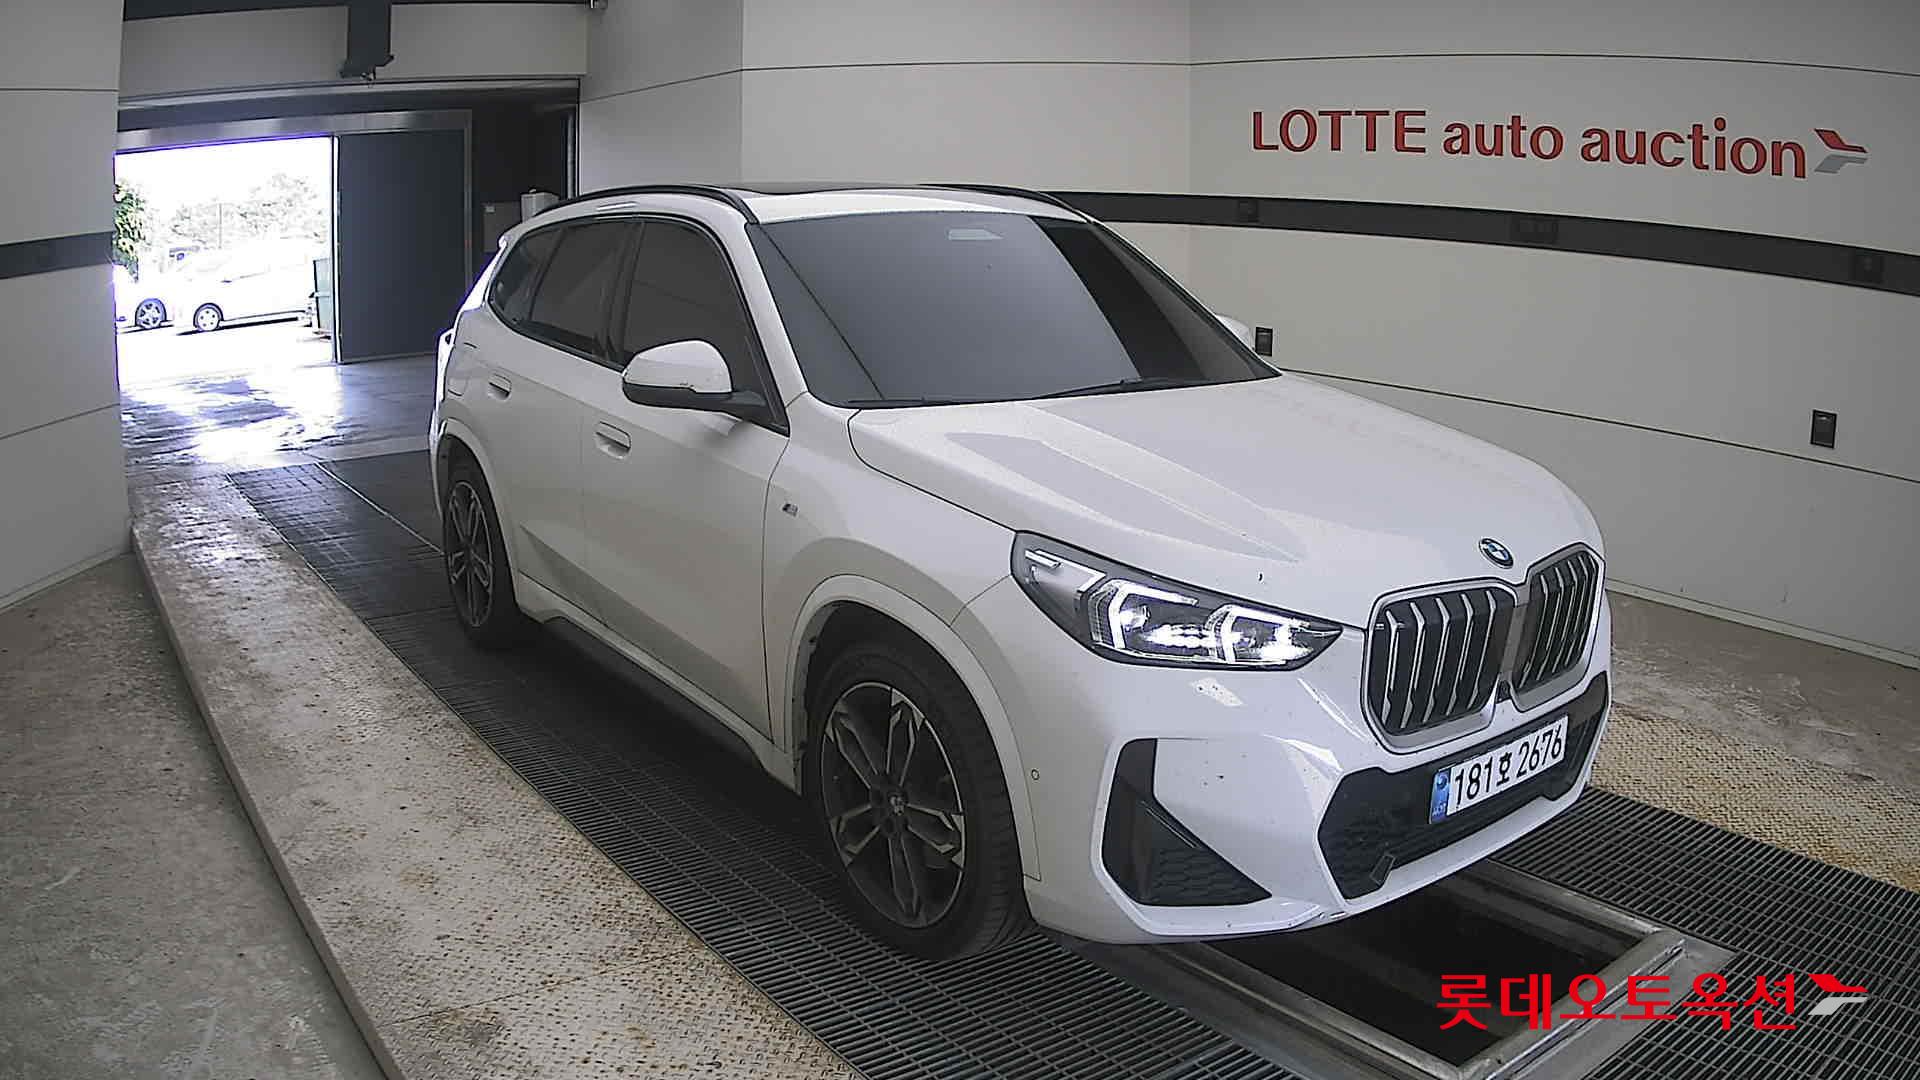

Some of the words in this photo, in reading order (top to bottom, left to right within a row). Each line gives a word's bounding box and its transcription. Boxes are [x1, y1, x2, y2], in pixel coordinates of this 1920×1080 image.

[1252, 109, 1427, 154] LOTTE
[1442, 114, 1565, 161] auto
[1580, 116, 1807, 180] auction
[1454, 751, 1513, 806] 181호
[1516, 724, 1563, 779] 2676
